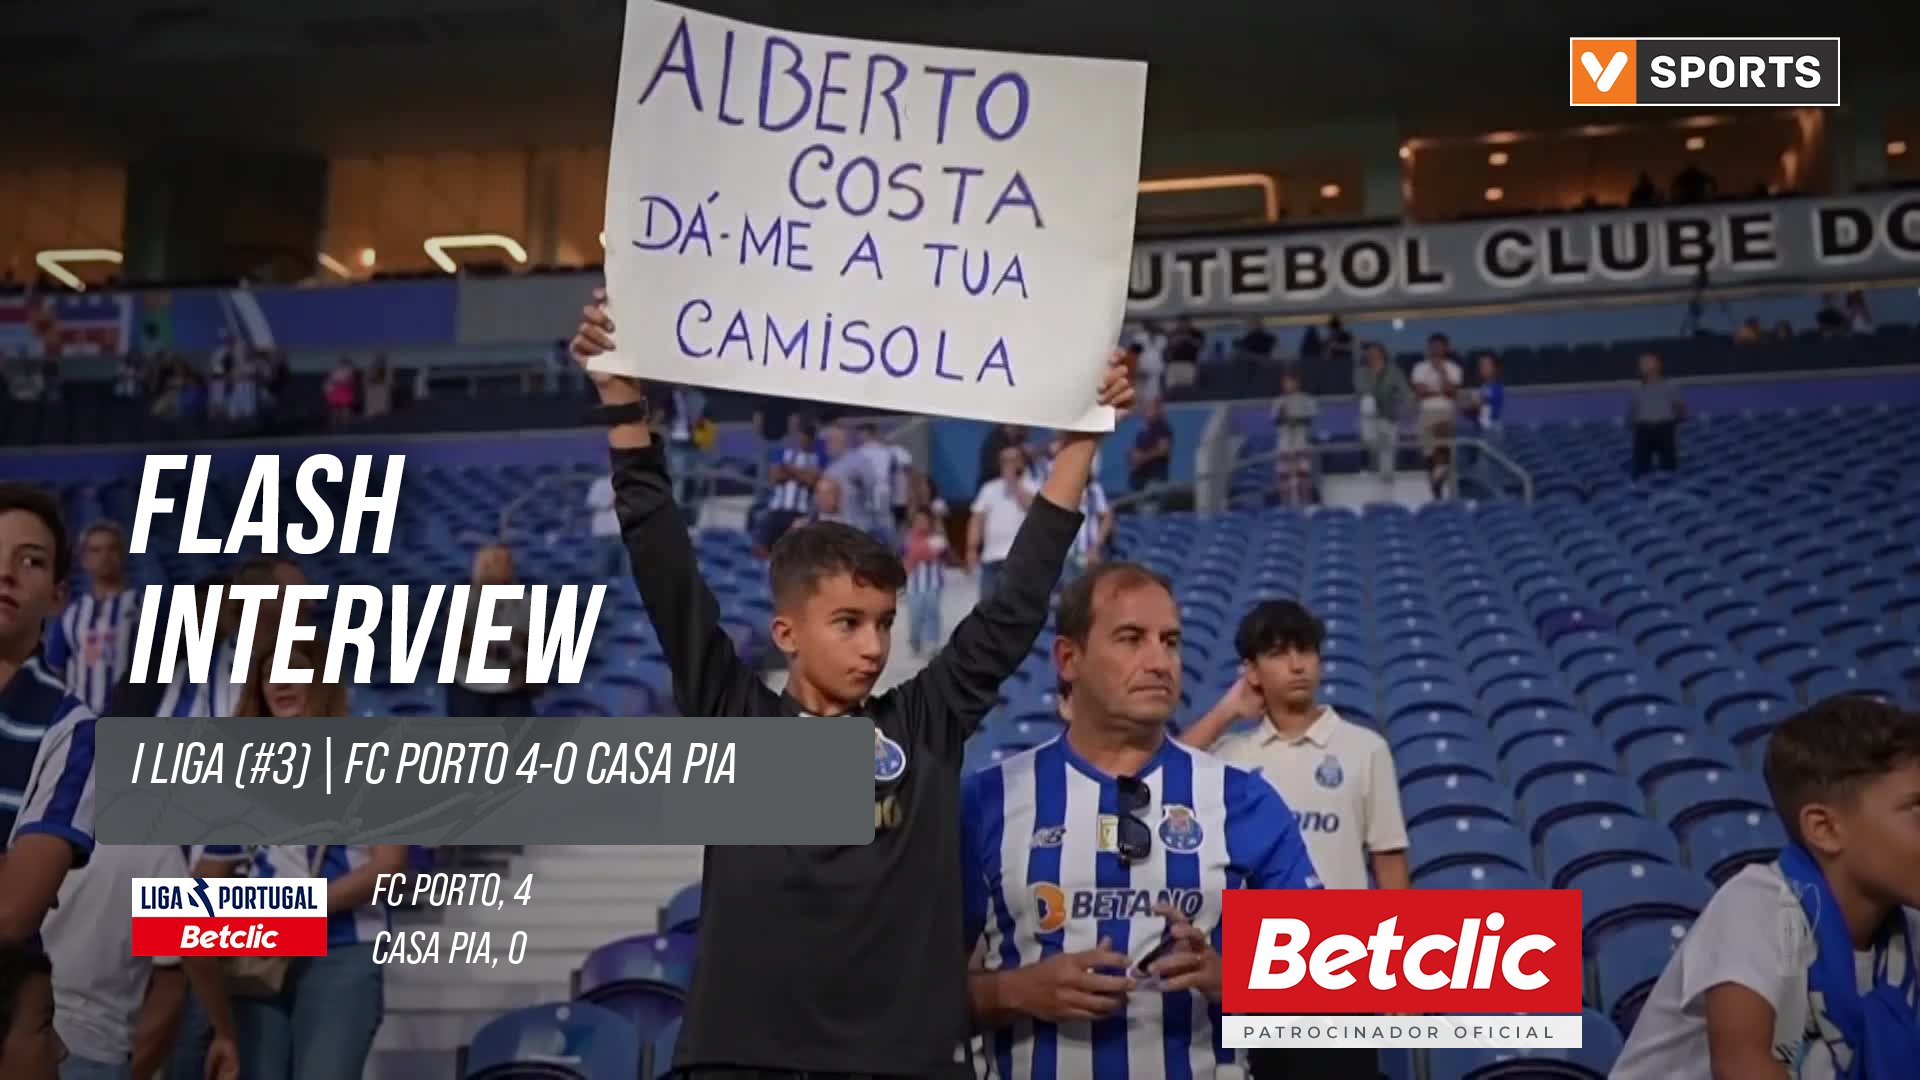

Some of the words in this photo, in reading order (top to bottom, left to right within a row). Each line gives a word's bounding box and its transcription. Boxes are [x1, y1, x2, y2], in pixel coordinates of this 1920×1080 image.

[638, 15, 1030, 144] ALBERTO
[789, 143, 1045, 229] COSTA
[632, 191, 814, 271] DÁ-ME
[840, 231, 884, 281] A
[924, 242, 1029, 299] TUA
[1484, 212, 1778, 280] CLUBE
[1071, 888, 1204, 920] BETANO
